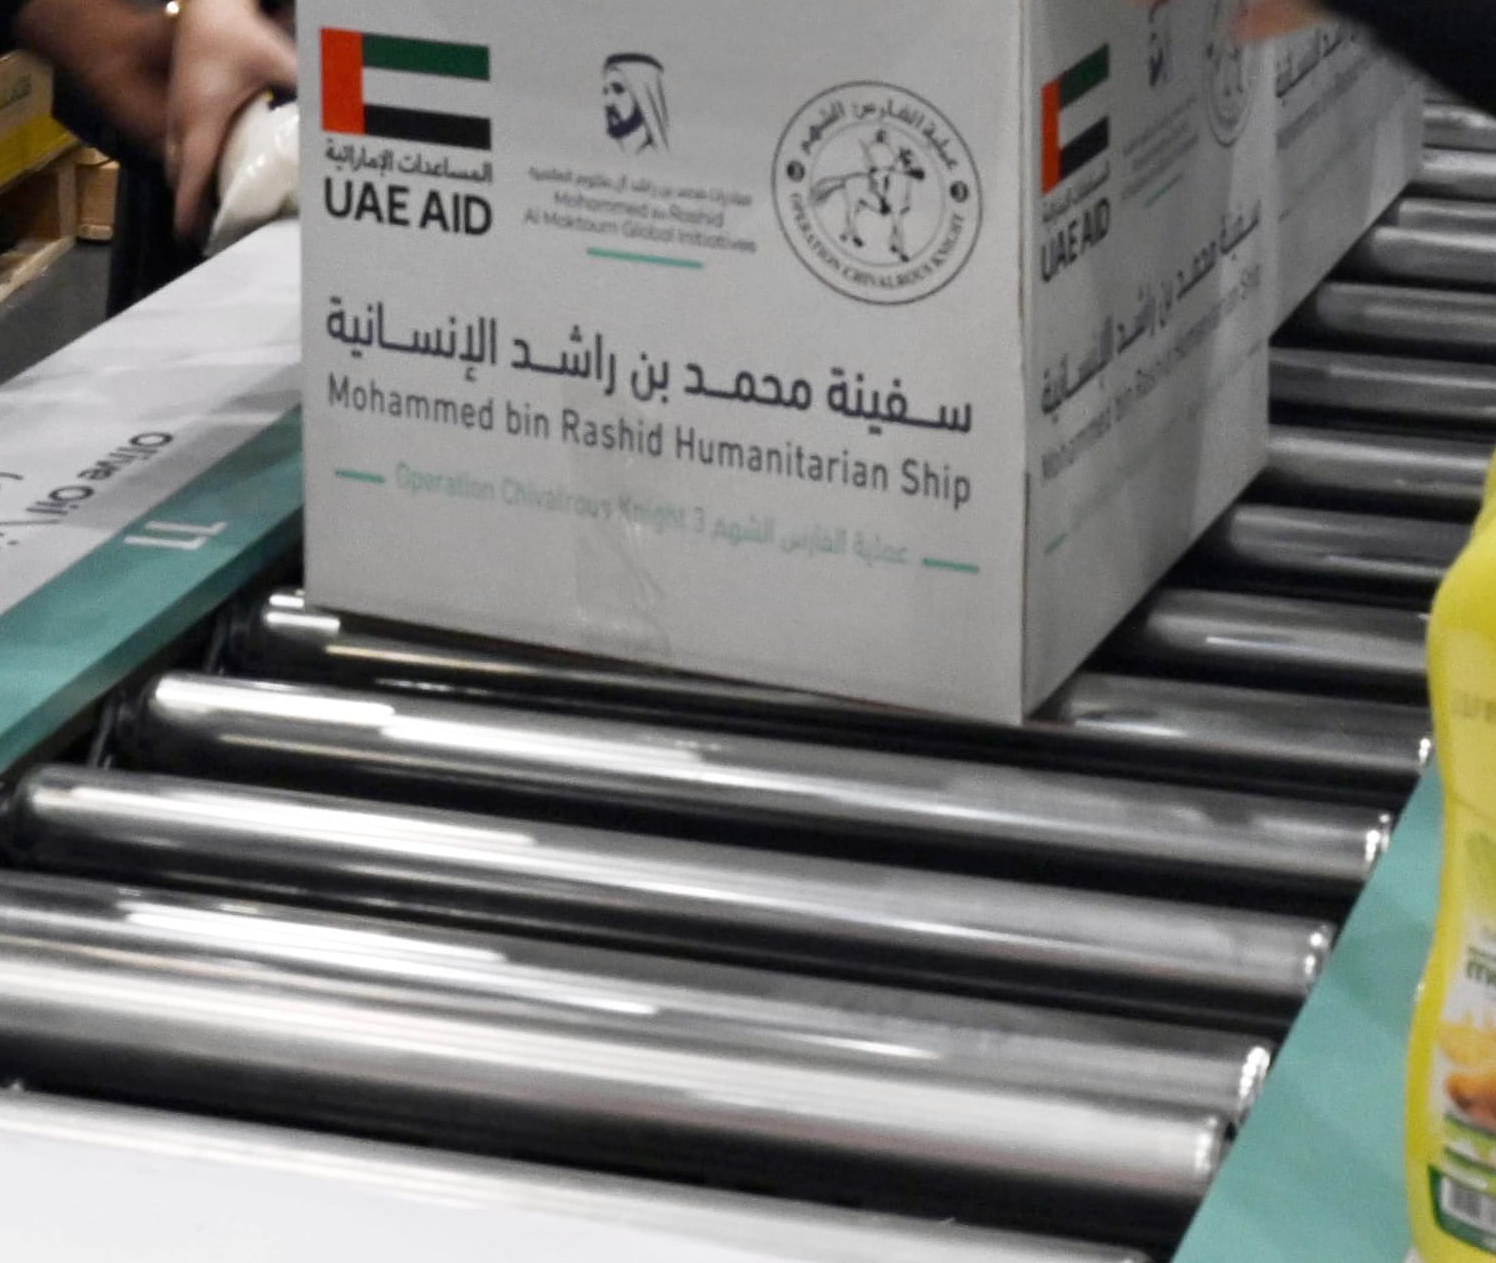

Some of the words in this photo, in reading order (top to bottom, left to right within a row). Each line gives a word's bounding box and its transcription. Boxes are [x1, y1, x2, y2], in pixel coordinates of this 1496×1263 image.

[325, 138, 394, 177] الإماراتية
[398, 152, 493, 183] المساعدات
[324, 176, 410, 226] UAE
[419, 188, 493, 236] AID
[1041, 218, 1078, 283] UAE
[327, 295, 498, 383] الإنسانية
[511, 324, 617, 397] راشد
[630, 351, 669, 404] بن
[684, 361, 813, 411] محمد
[827, 366, 972, 435] سفينة
[77, 430, 174, 481] Olive
[328, 371, 495, 432] Mohammed
[506, 400, 550, 440] bin
[561, 407, 664, 458] Rashid
[675, 424, 889, 492] Humanitarian
[901, 457, 972, 511] Ship
[25, 484, 95, 516] Oil
[395, 460, 495, 502] Operation
[501, 476, 612, 520] Chivalrous
[617, 494, 686, 534] Knight
